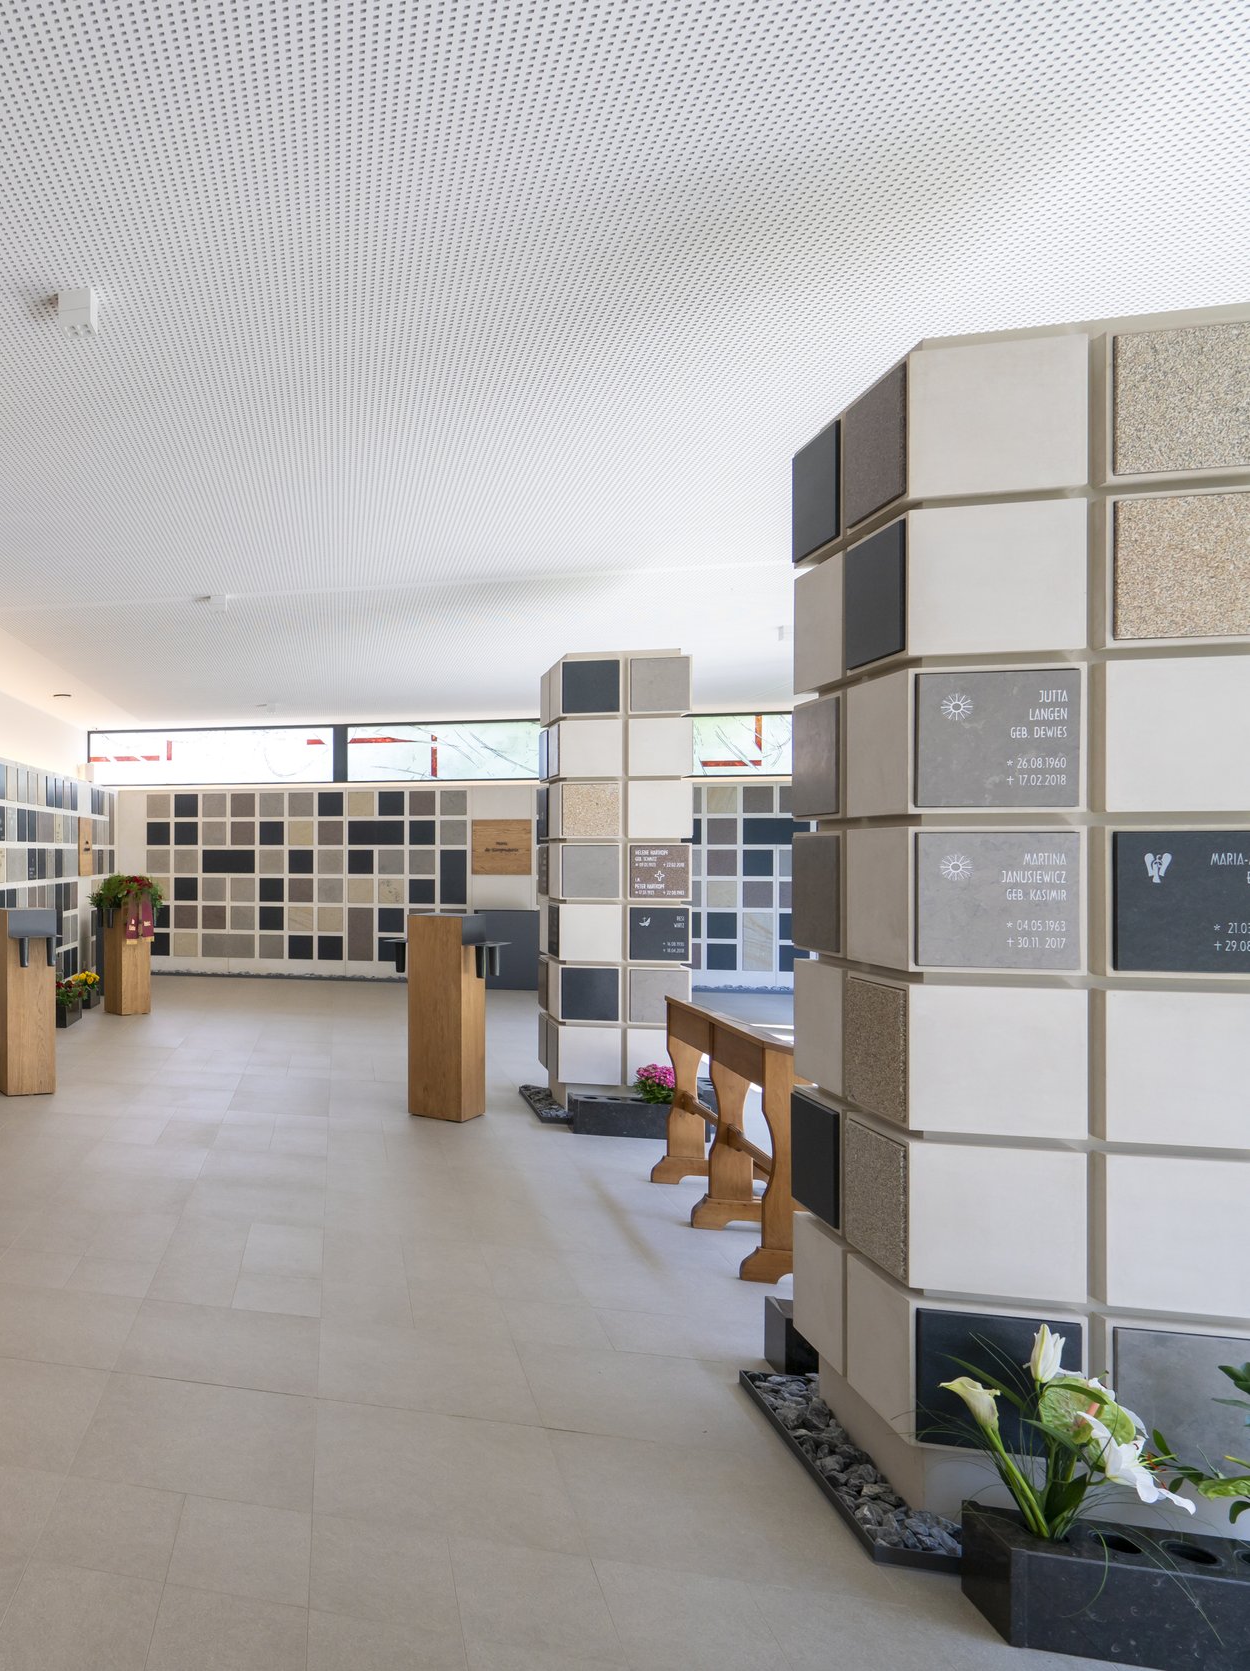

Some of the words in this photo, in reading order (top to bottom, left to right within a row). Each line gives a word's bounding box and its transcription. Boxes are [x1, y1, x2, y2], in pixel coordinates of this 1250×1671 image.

[1038, 689, 1068, 703] JUTTA
[1029, 707, 1068, 721] LANGEN
[1010, 726, 1030, 739] GEB.
[1034, 726, 1068, 738] DEWIES
[1017, 757, 1067, 769] 26.08.1960
[1019, 774, 1067, 786] 17.02.2018
[1023, 852, 1067, 865] MARTINA
[1210, 852, 1250, 866] MARIA-
[1001, 870, 1067, 884] JANUSIEWICZ
[1006, 888, 1027, 901] GEB.
[1030, 889, 1067, 901] KASIMIR
[1016, 920, 1067, 931] 04.05.1963
